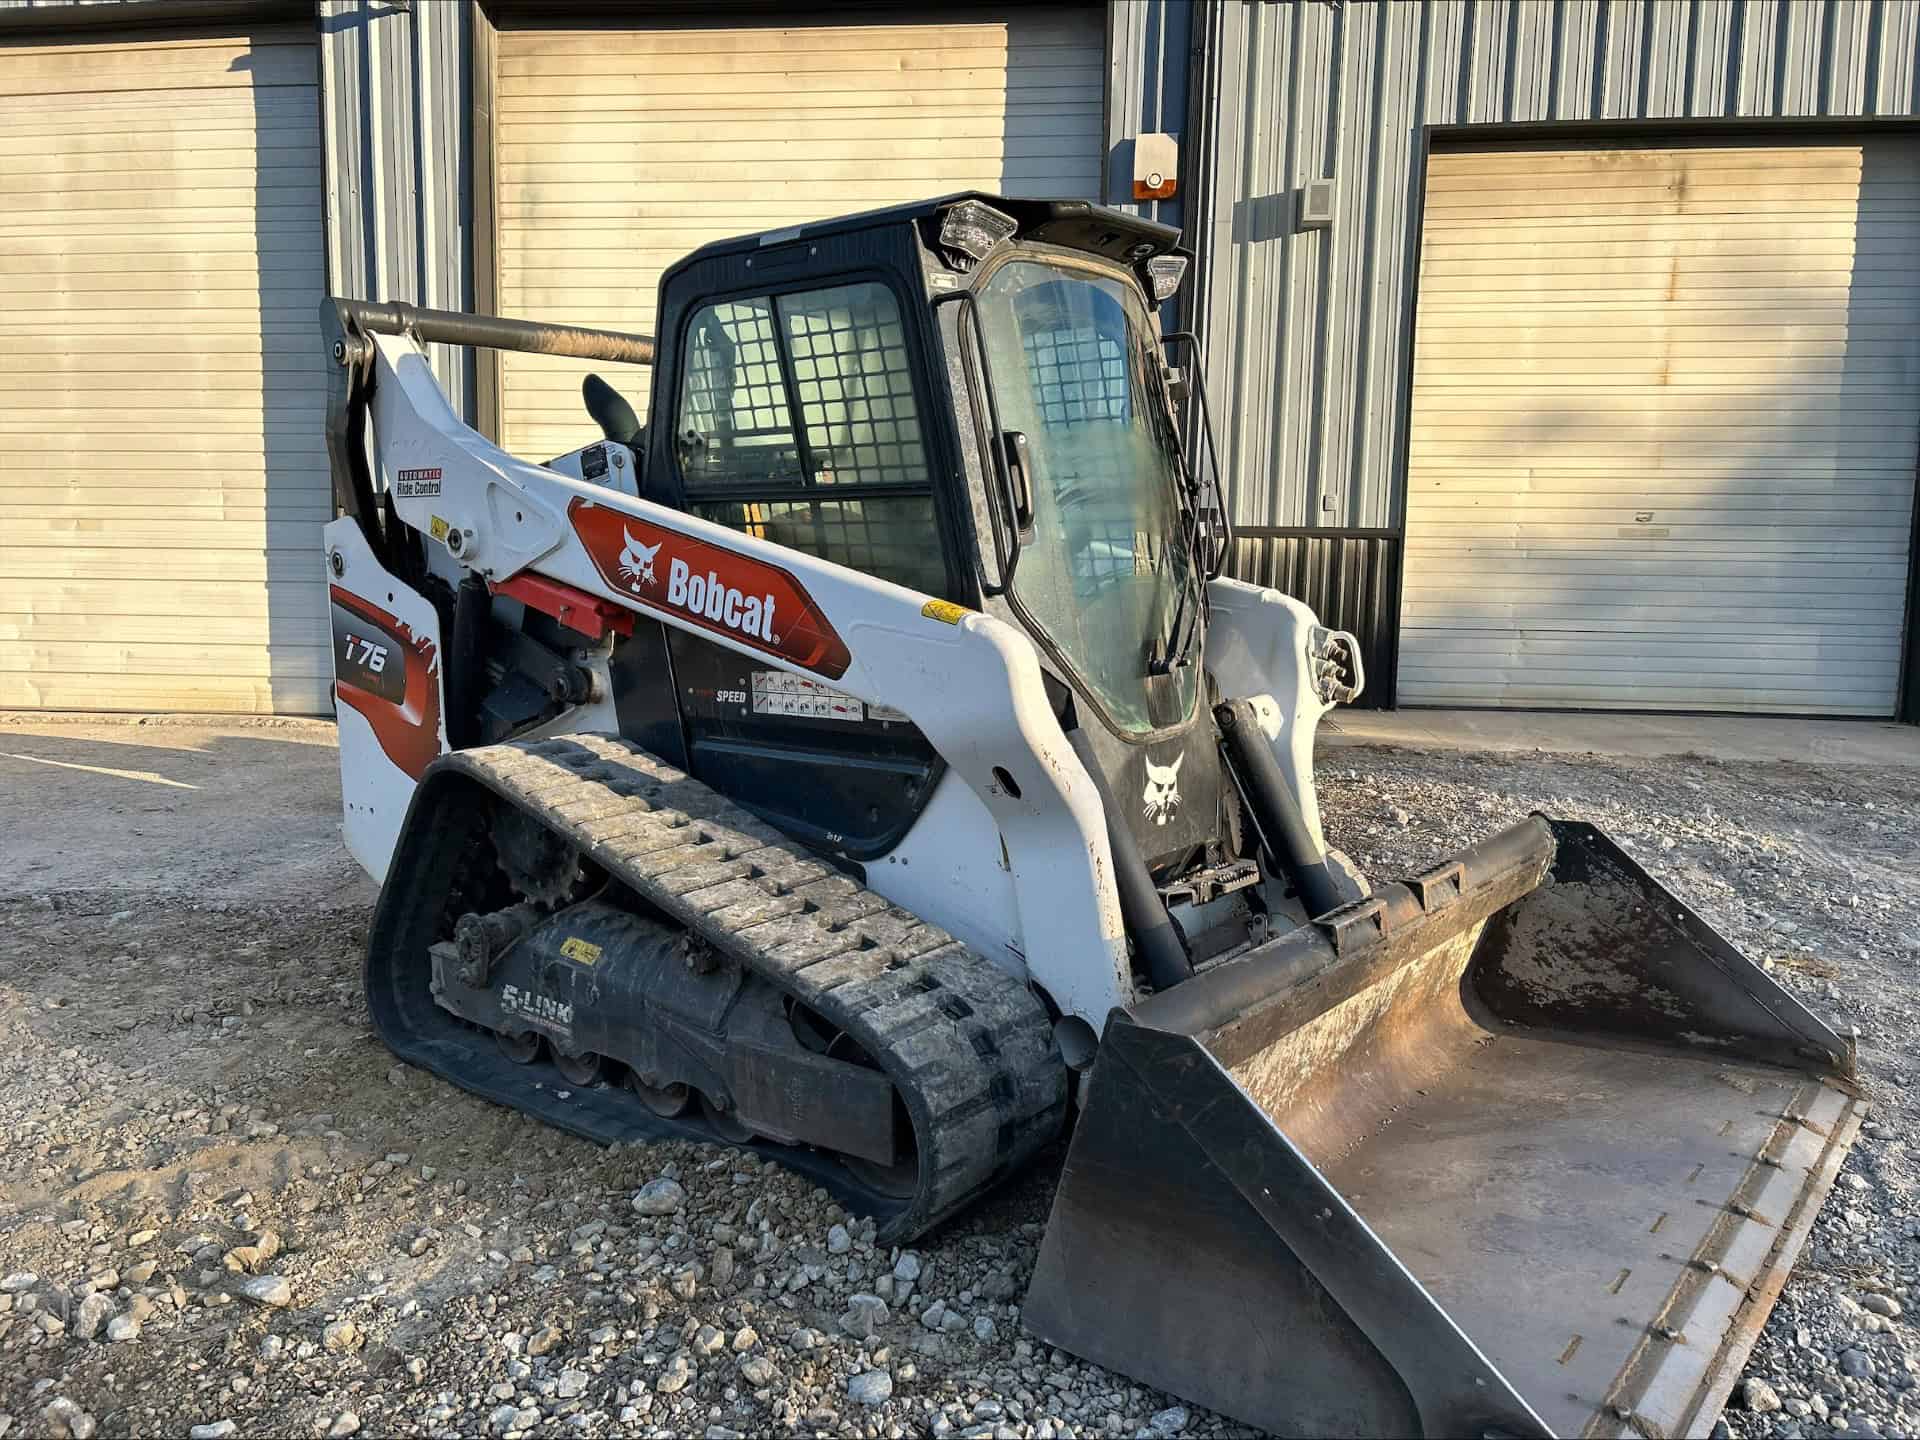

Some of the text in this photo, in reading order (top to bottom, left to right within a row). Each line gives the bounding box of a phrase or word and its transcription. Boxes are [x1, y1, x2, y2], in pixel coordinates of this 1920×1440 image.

[399, 470, 441, 480] AUTOMATIC
[397, 481, 441, 496] Ride Control
[667, 556, 776, 642] Bobcat
[716, 690, 746, 703] SPEED
